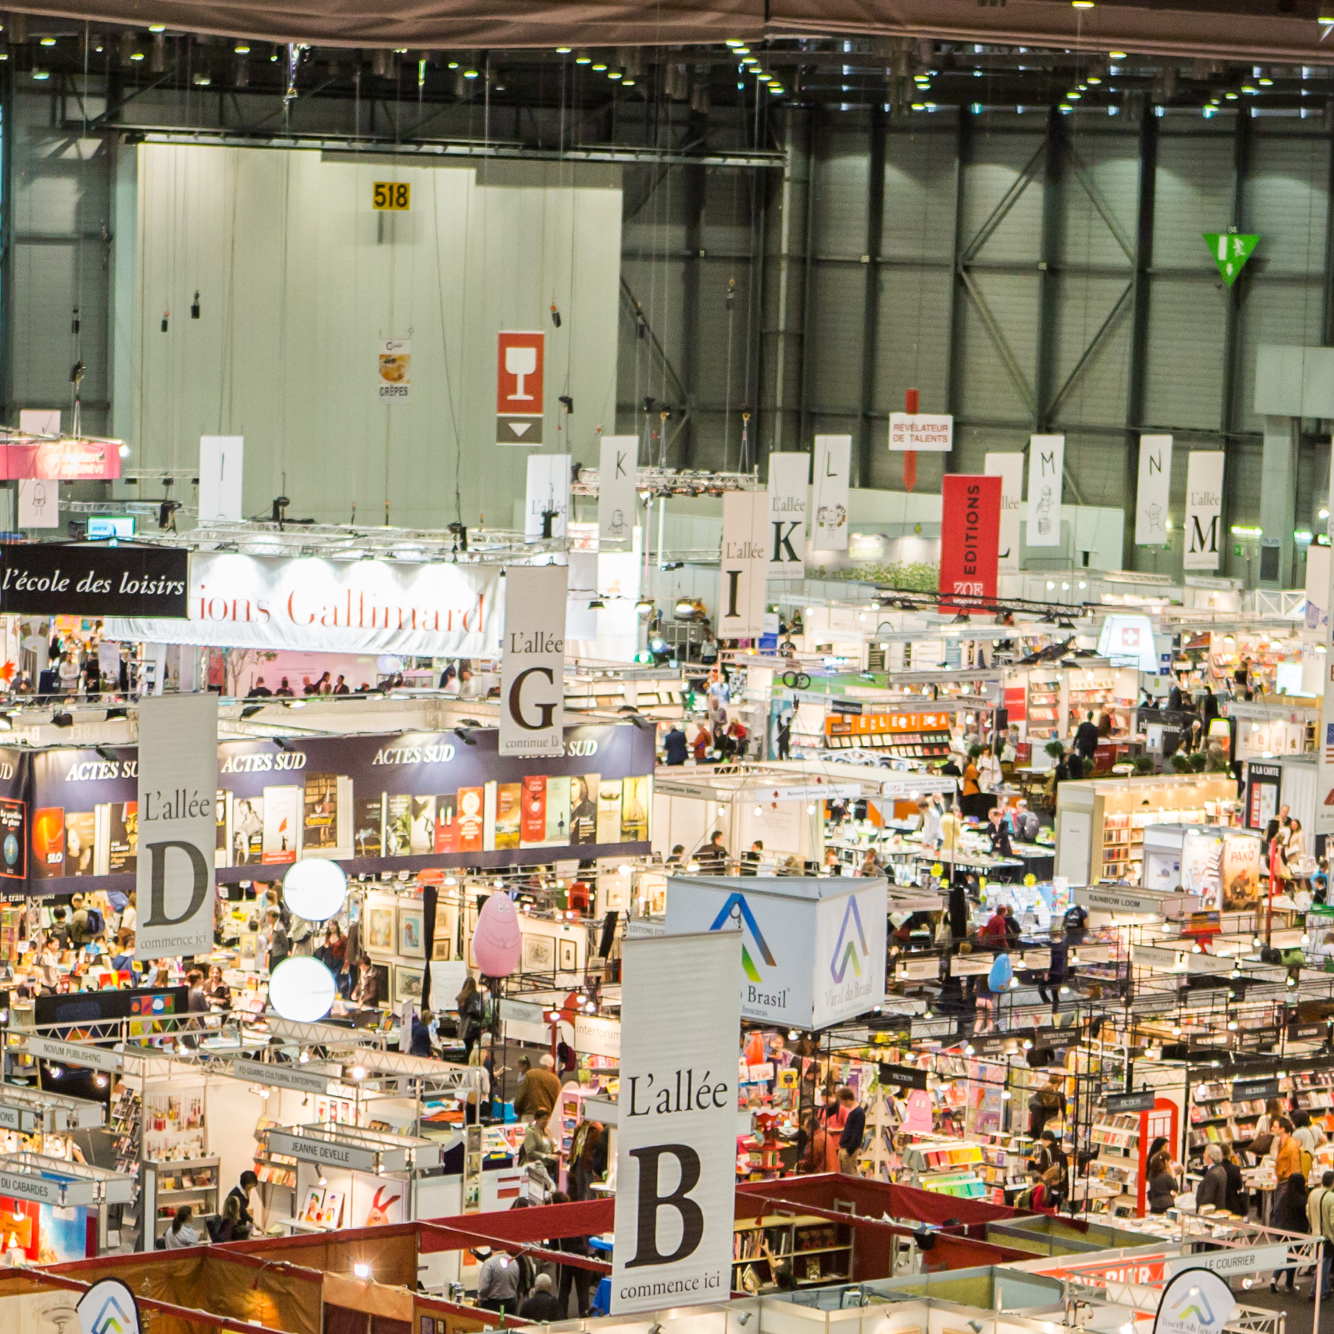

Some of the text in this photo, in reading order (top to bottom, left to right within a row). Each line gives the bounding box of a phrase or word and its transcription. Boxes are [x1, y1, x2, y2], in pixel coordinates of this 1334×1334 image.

[374, 183, 409, 209] 518
[893, 434, 948, 444] DE TALENTS
[769, 520, 803, 562] K
[963, 484, 981, 576] EDITIONS
[1188, 515, 1220, 554] M
[76, 570, 111, 594] des
[119, 572, 186, 597] loisirs
[510, 632, 564, 655] L'allée
[509, 667, 558, 731] G
[221, 751, 306, 773] ACTES SUD
[372, 744, 456, 766] ACTES SUD
[144, 789, 211, 822] L'allée
[142, 840, 209, 928] D
[1088, 894, 1140, 908] RAINBOW LOOM
[140, 932, 207, 950] commence ici
[748, 985, 786, 1009] Brasil
[43, 1042, 102, 1064] NOVUM PUBLISHING
[239, 1065, 323, 1090] FO GUANG CULTURAL ENTERPRISE
[627, 1069, 728, 1118] L'allée
[292, 1141, 350, 1163] JEANNE DEVELLE
[1, 1178, 11, 1190] DU
[13, 1179, 49, 1198] CABARDES
[624, 1143, 707, 1269] B
[1204, 1254, 1255, 1271] LE COURRIER
[620, 1270, 721, 1301] commence ici
